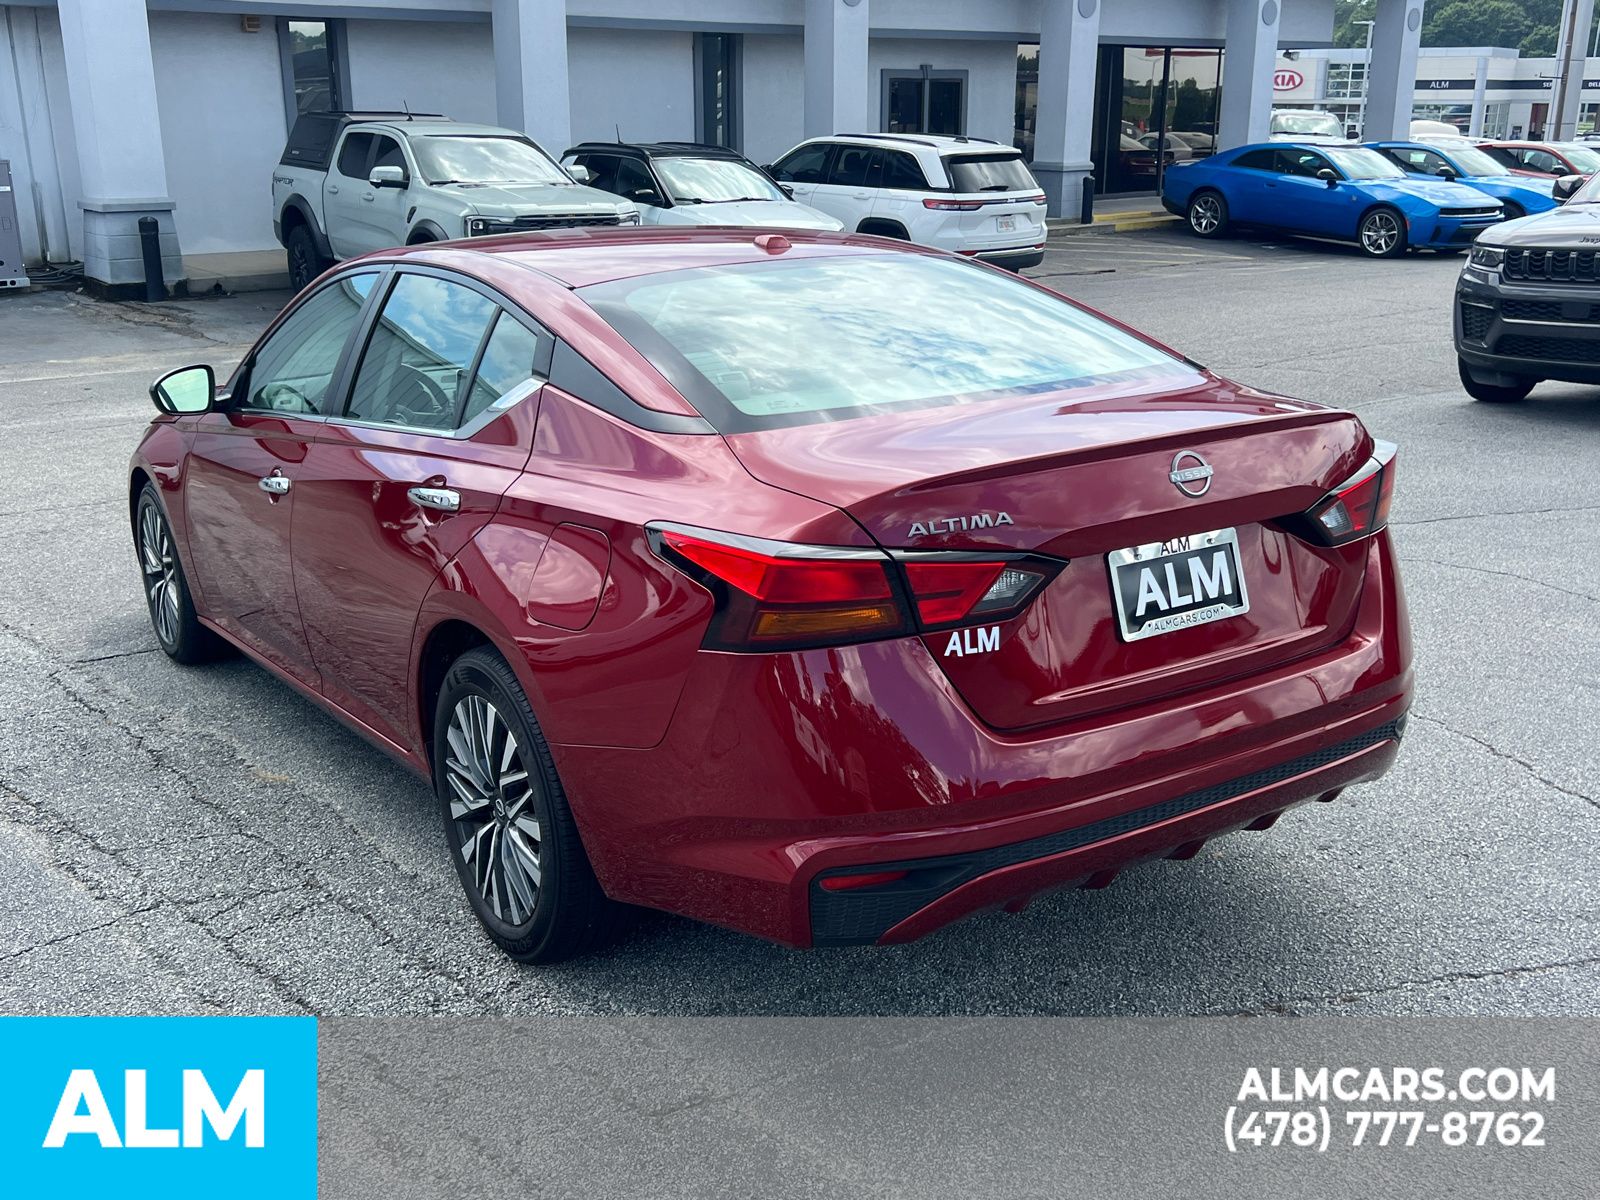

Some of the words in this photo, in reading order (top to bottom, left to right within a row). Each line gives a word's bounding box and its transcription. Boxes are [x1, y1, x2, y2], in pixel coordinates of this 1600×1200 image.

[1429, 80, 1450, 89] ALM
[1171, 467, 1213, 483] NISSAN
[907, 511, 1014, 539] ALTIMA
[1160, 536, 1191, 556] ALM
[1135, 550, 1233, 617] ALM
[1153, 608, 1220, 632] ALMCARS.COM
[944, 626, 1000, 657] ALM
